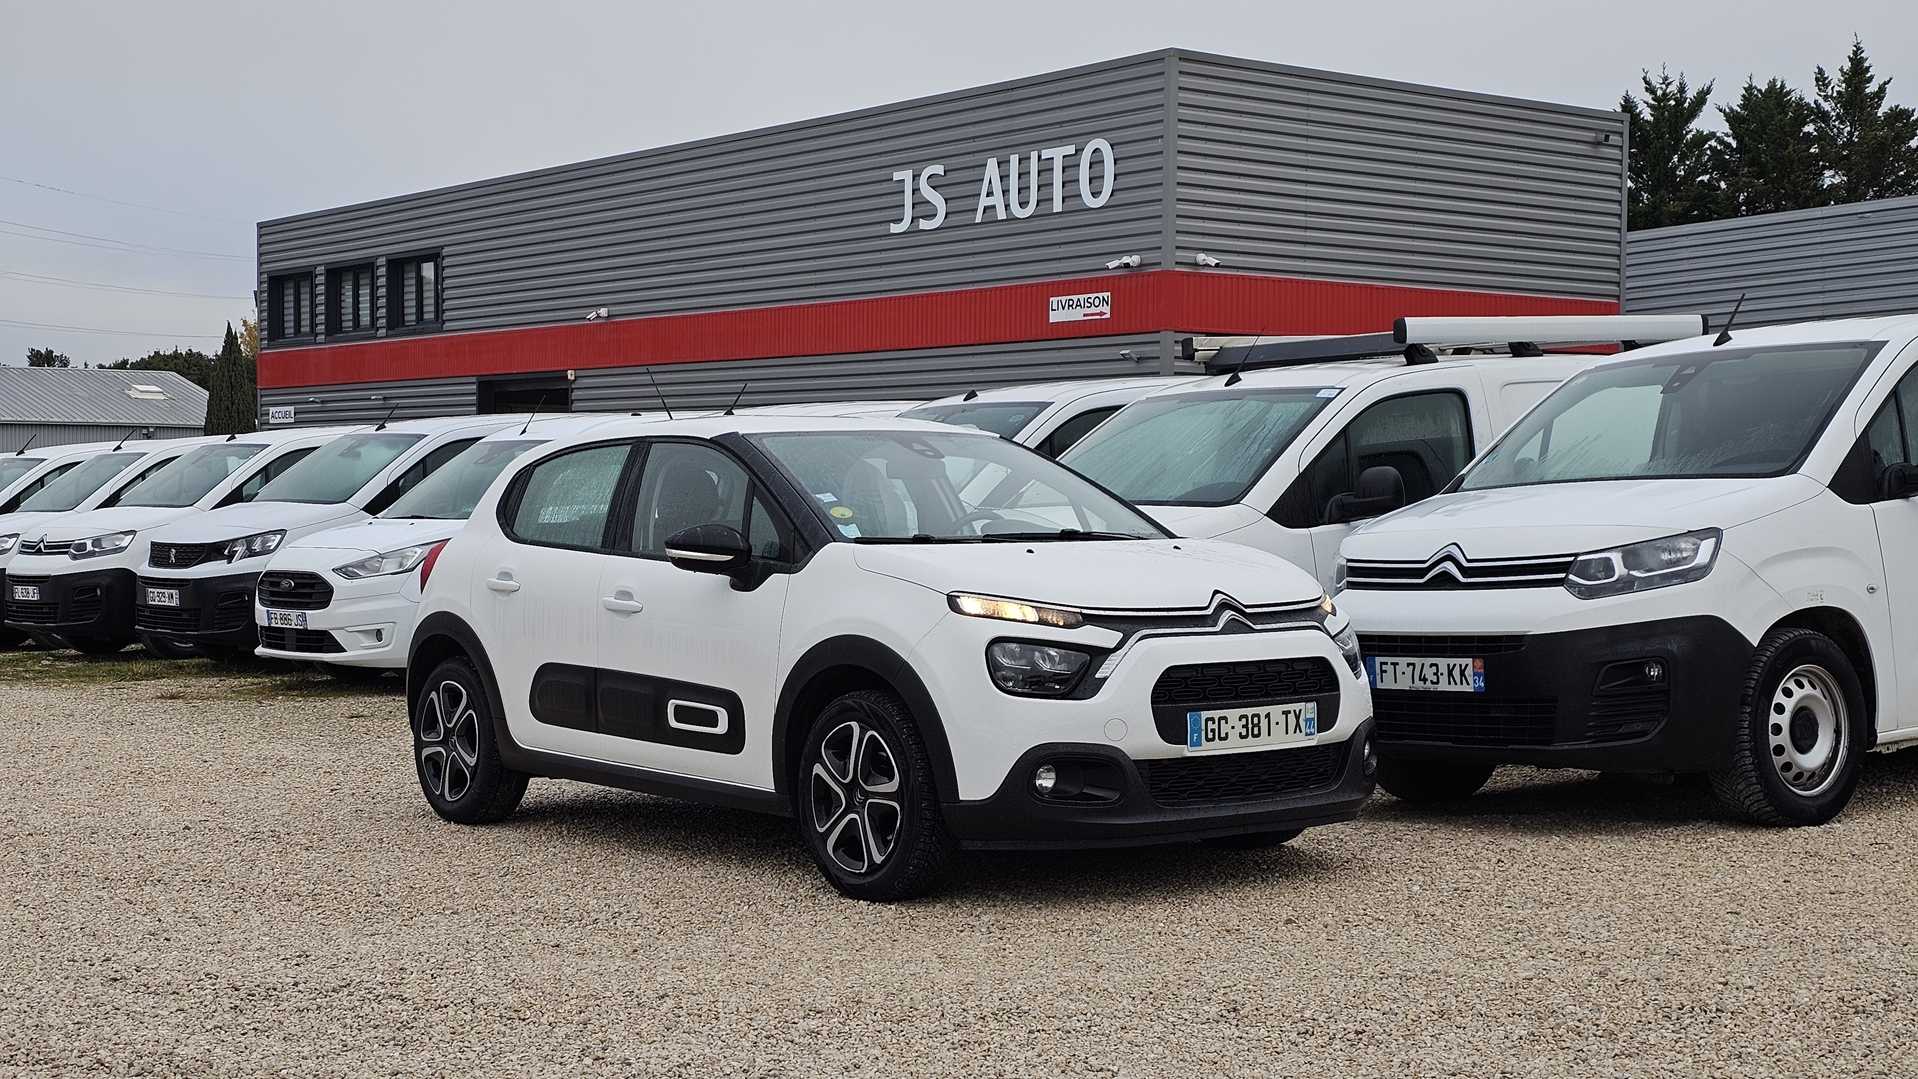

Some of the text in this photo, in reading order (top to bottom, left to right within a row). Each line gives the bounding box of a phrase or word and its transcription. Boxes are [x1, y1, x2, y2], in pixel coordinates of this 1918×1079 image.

[889, 138, 1115, 233] JS AUTO
[1051, 295, 1110, 312] LIVRAISON
[271, 410, 293, 419] ACCUEIL
[1379, 661, 1471, 686] FT-743-KK
[1473, 676, 1484, 688] 34
[1204, 708, 1303, 742] GC-381-TX
[1305, 722, 1314, 734] 44
[1193, 733, 1199, 743] F
